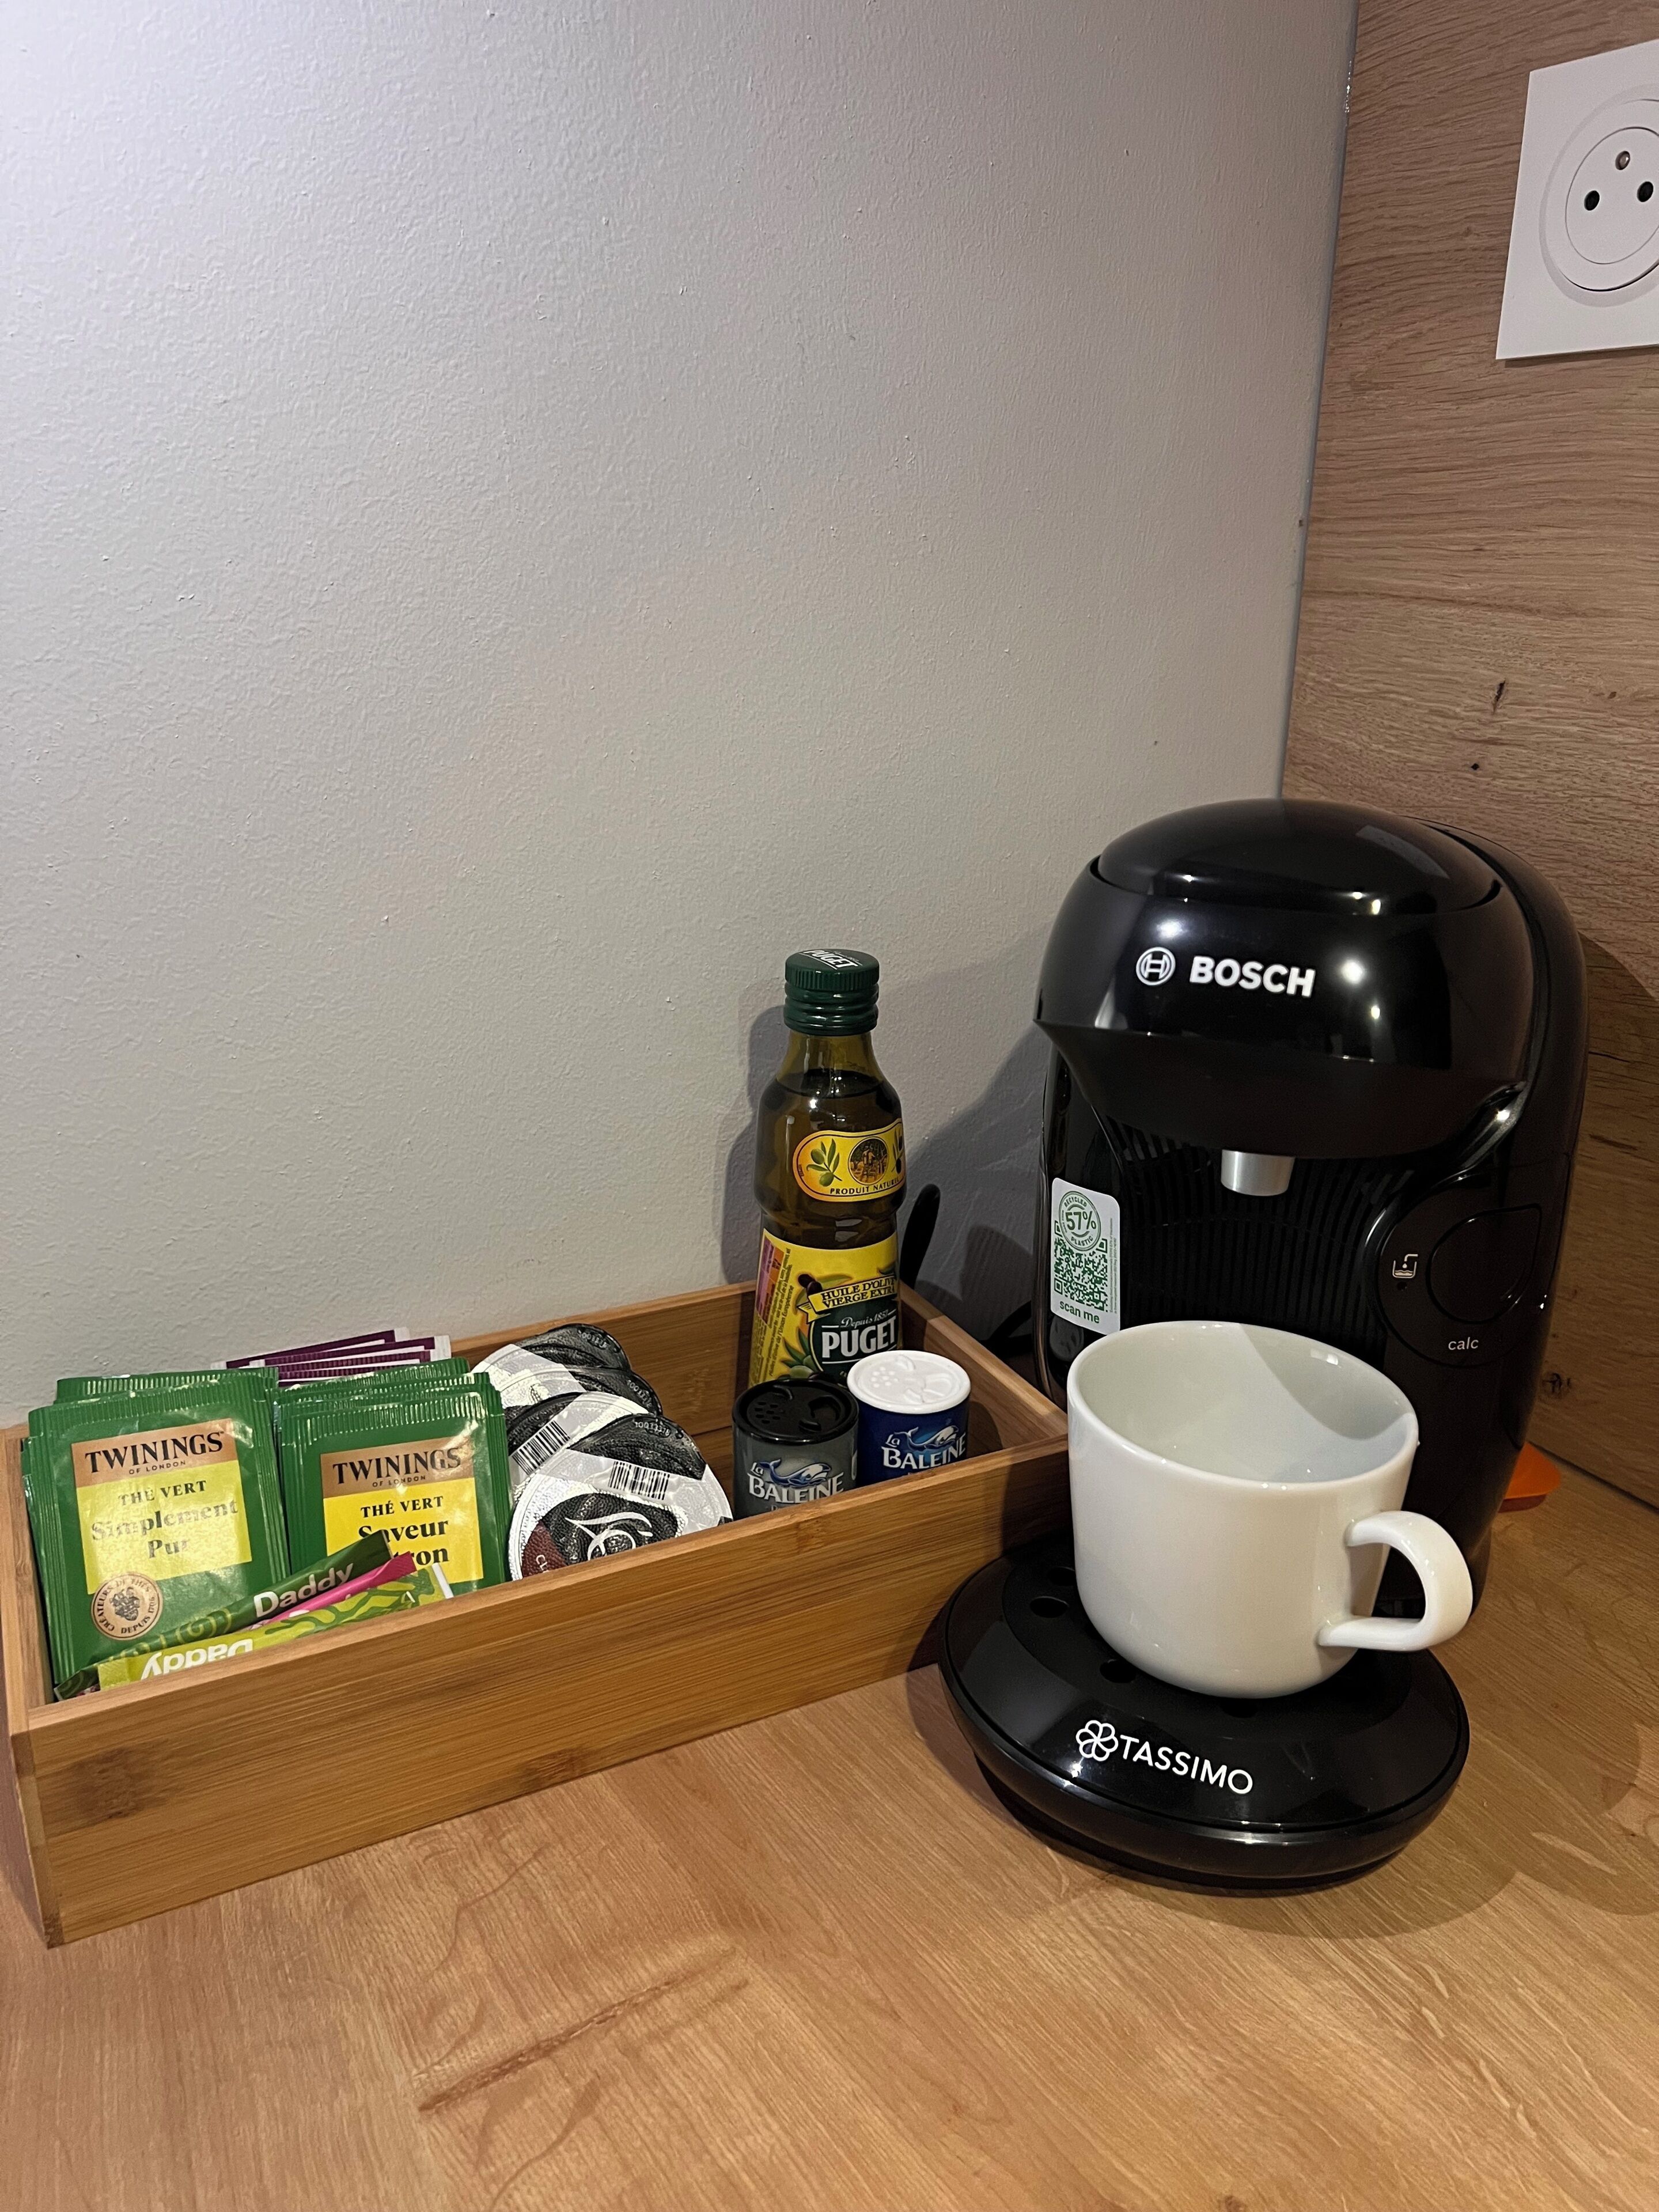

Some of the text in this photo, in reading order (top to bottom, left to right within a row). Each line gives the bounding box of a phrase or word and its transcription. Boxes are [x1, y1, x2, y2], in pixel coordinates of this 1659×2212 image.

[803, 949, 858, 968] PUGET
[1189, 955, 1316, 998] BOSCH
[830, 1185, 870, 1195] PRODUIT
[1063, 1196, 1088, 1208] RECYCLED
[1065, 1210, 1097, 1230] 57%
[1071, 1235, 1093, 1247] PLASTIC
[820, 1284, 861, 1301] HUILE
[822, 1291, 868, 1308] VIERGE
[1060, 1301, 1100, 1324] scan me
[840, 1316, 873, 1329] Depuis
[821, 1315, 896, 1358] PUGET
[1448, 1336, 1479, 1350] calc
[881, 1431, 967, 1469] BALEINE
[885, 1434, 900, 1448] La
[85, 1431, 224, 1473] TWININGS
[146, 1460, 186, 1472] LONDON
[332, 1447, 461, 1484] TWININGS
[750, 1462, 764, 1477] La
[160, 1480, 207, 1498] VERT
[388, 1475, 426, 1486] LONDON
[747, 1471, 844, 1504] BALEINE
[361, 1495, 444, 1518] THÉ VERT
[92, 1499, 239, 1540] Simplement
[147, 1539, 190, 1559] Pur
[253, 1563, 354, 1618] Daddy
[121, 1615, 151, 1634] DEPUIS
[141, 1638, 253, 1681] Daddy
[1119, 1734, 1253, 1794] TASSIMO
